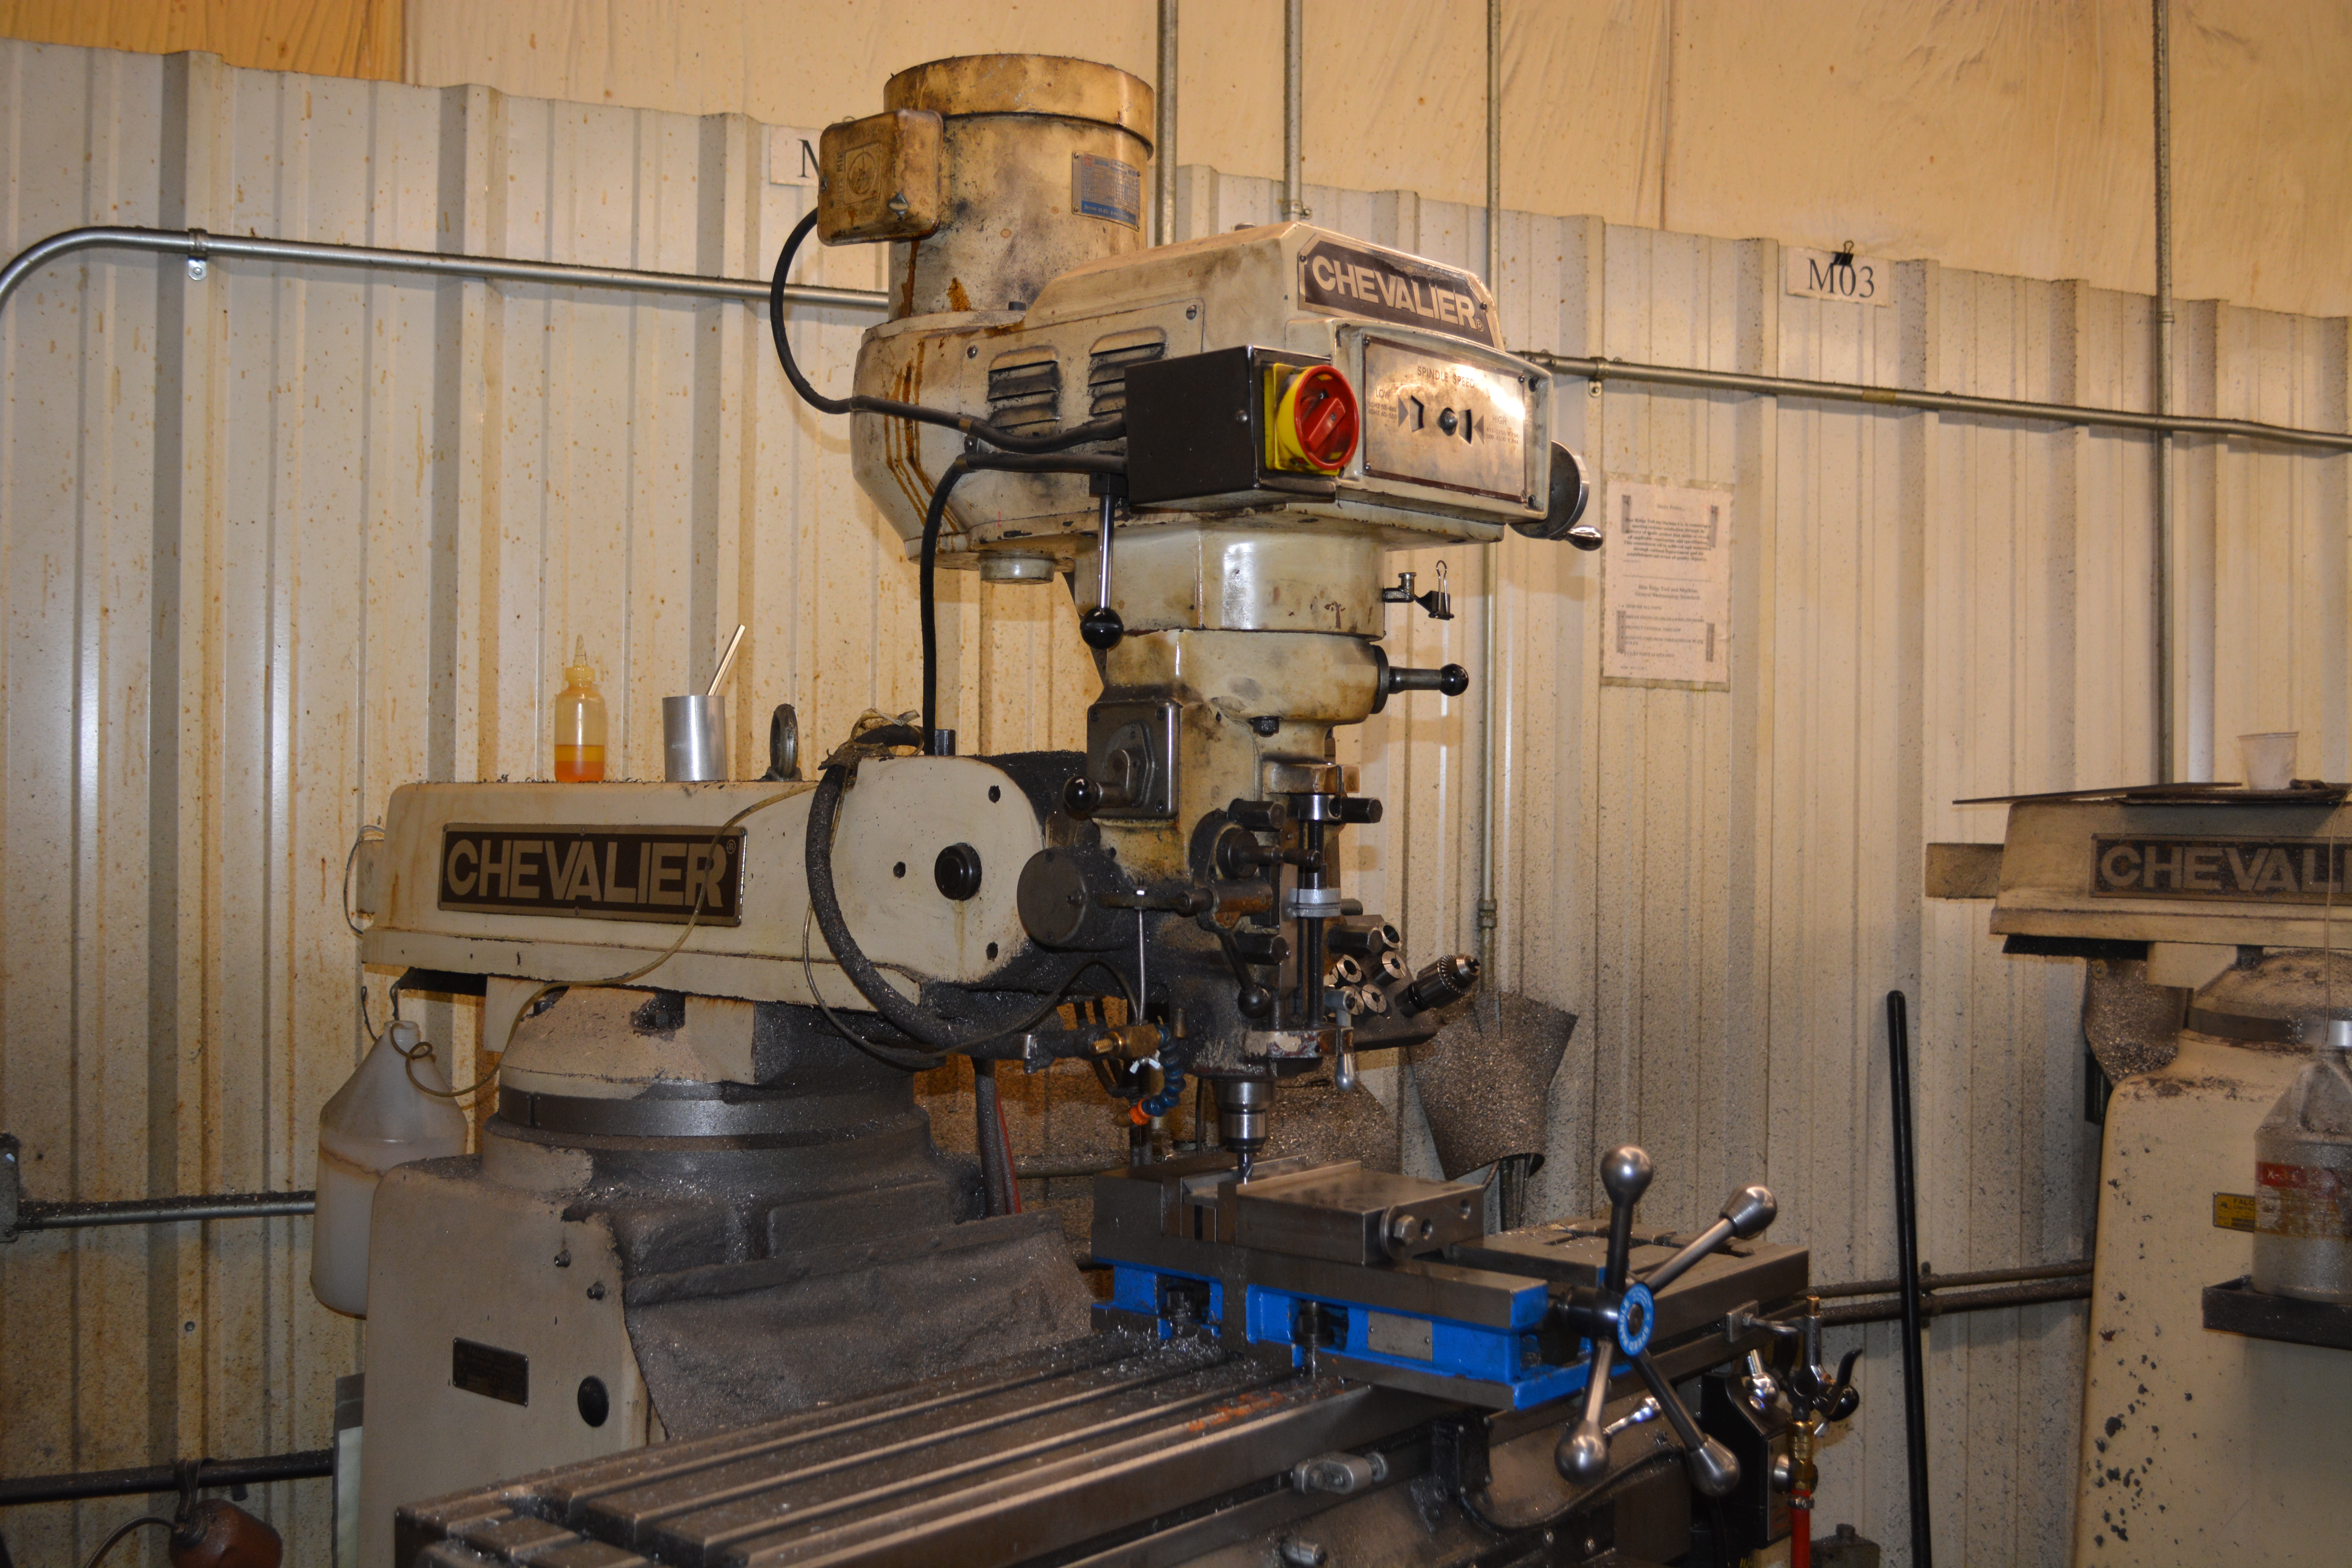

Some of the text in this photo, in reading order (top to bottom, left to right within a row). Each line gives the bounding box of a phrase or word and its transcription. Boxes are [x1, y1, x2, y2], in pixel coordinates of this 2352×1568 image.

[1312, 255, 1477, 330] CHEVALIER
[1808, 258, 1874, 298] M03
[1417, 365, 1475, 388] SPINDLE SPEED
[1376, 388, 1390, 399] LOW
[1492, 415, 1506, 425] HIGH
[447, 839, 727, 907] CHEVALIER
